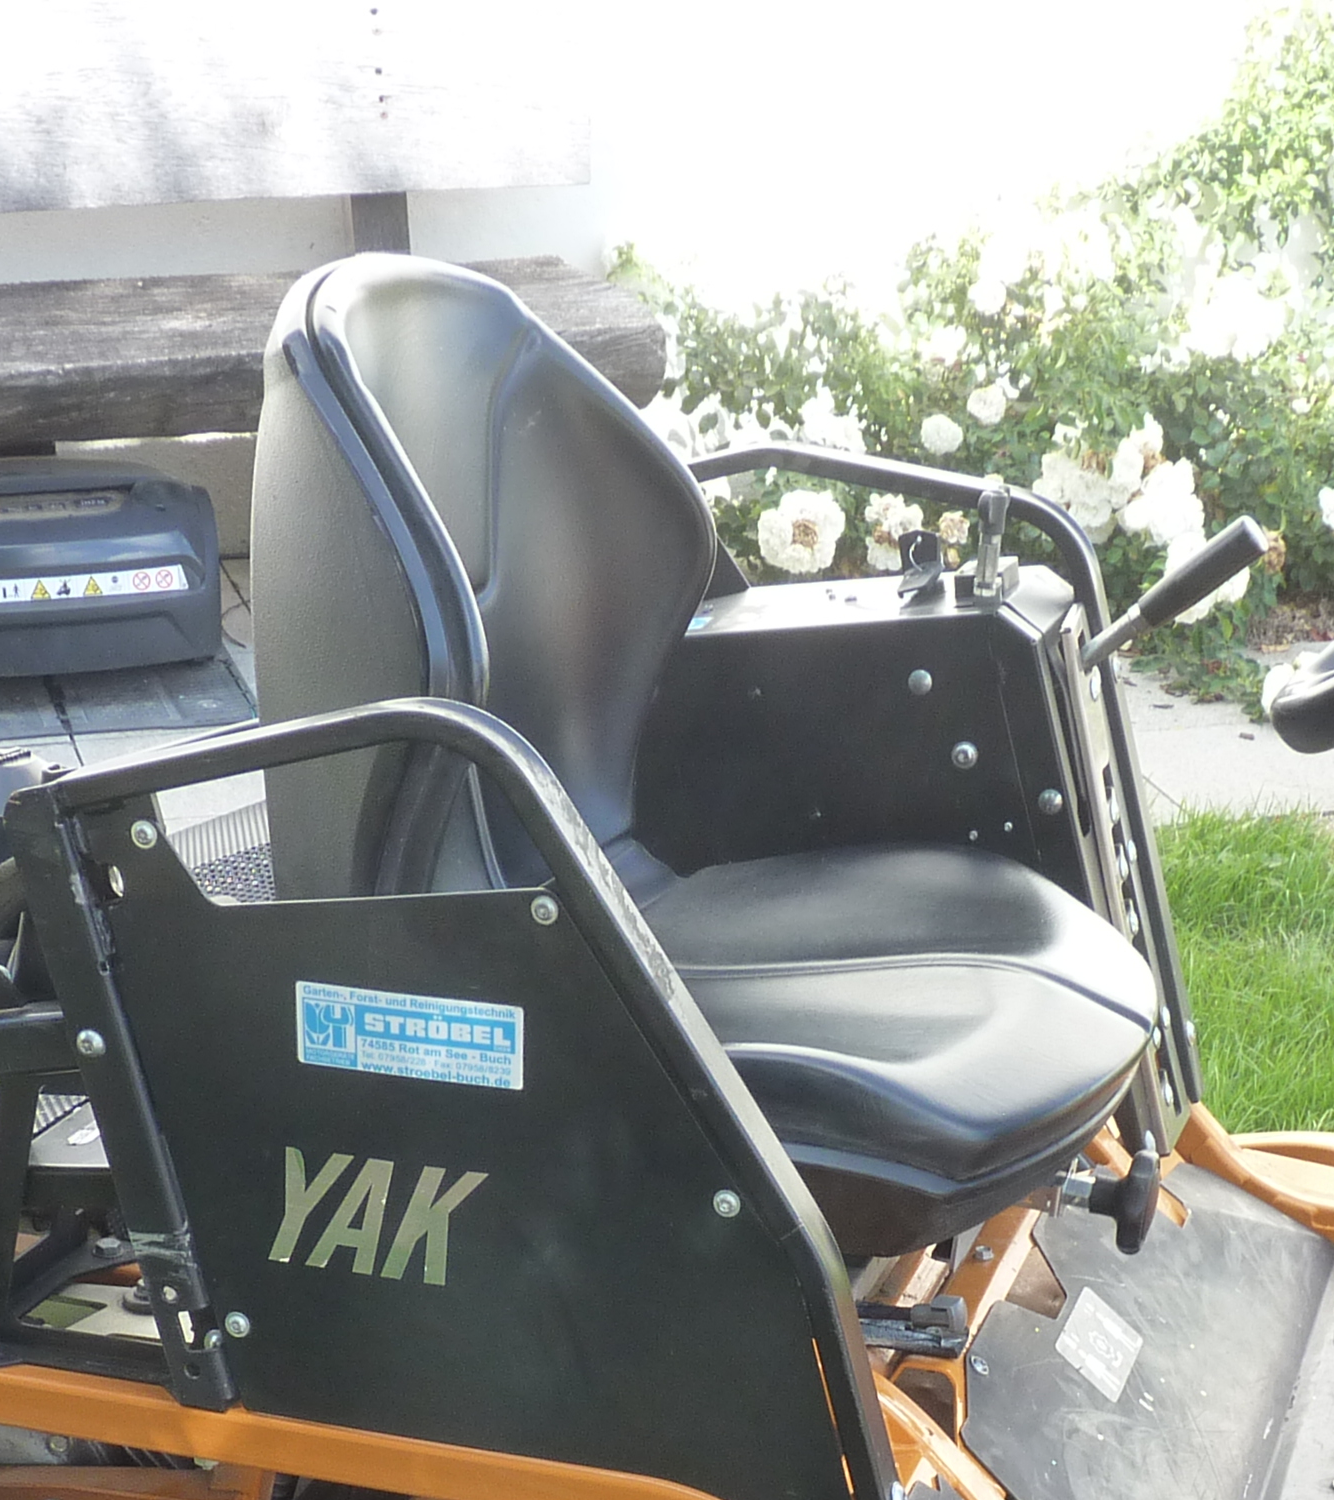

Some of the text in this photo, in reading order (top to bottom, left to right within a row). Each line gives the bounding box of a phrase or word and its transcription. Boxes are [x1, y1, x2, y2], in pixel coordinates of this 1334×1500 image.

[349, 991, 382, 1005] Forst-
[385, 997, 406, 1009] und
[410, 998, 516, 1020] Reinigungstechnik
[364, 1013, 511, 1047] STRÖBEL
[361, 1038, 396, 1052] 74585
[399, 1041, 420, 1055] Rot
[423, 1047, 441, 1057] am
[445, 1047, 468, 1060] See
[480, 1052, 511, 1065] Buch
[361, 1062, 511, 1087] www.stroebel-buch.de
[268, 1146, 489, 1286] YAK
